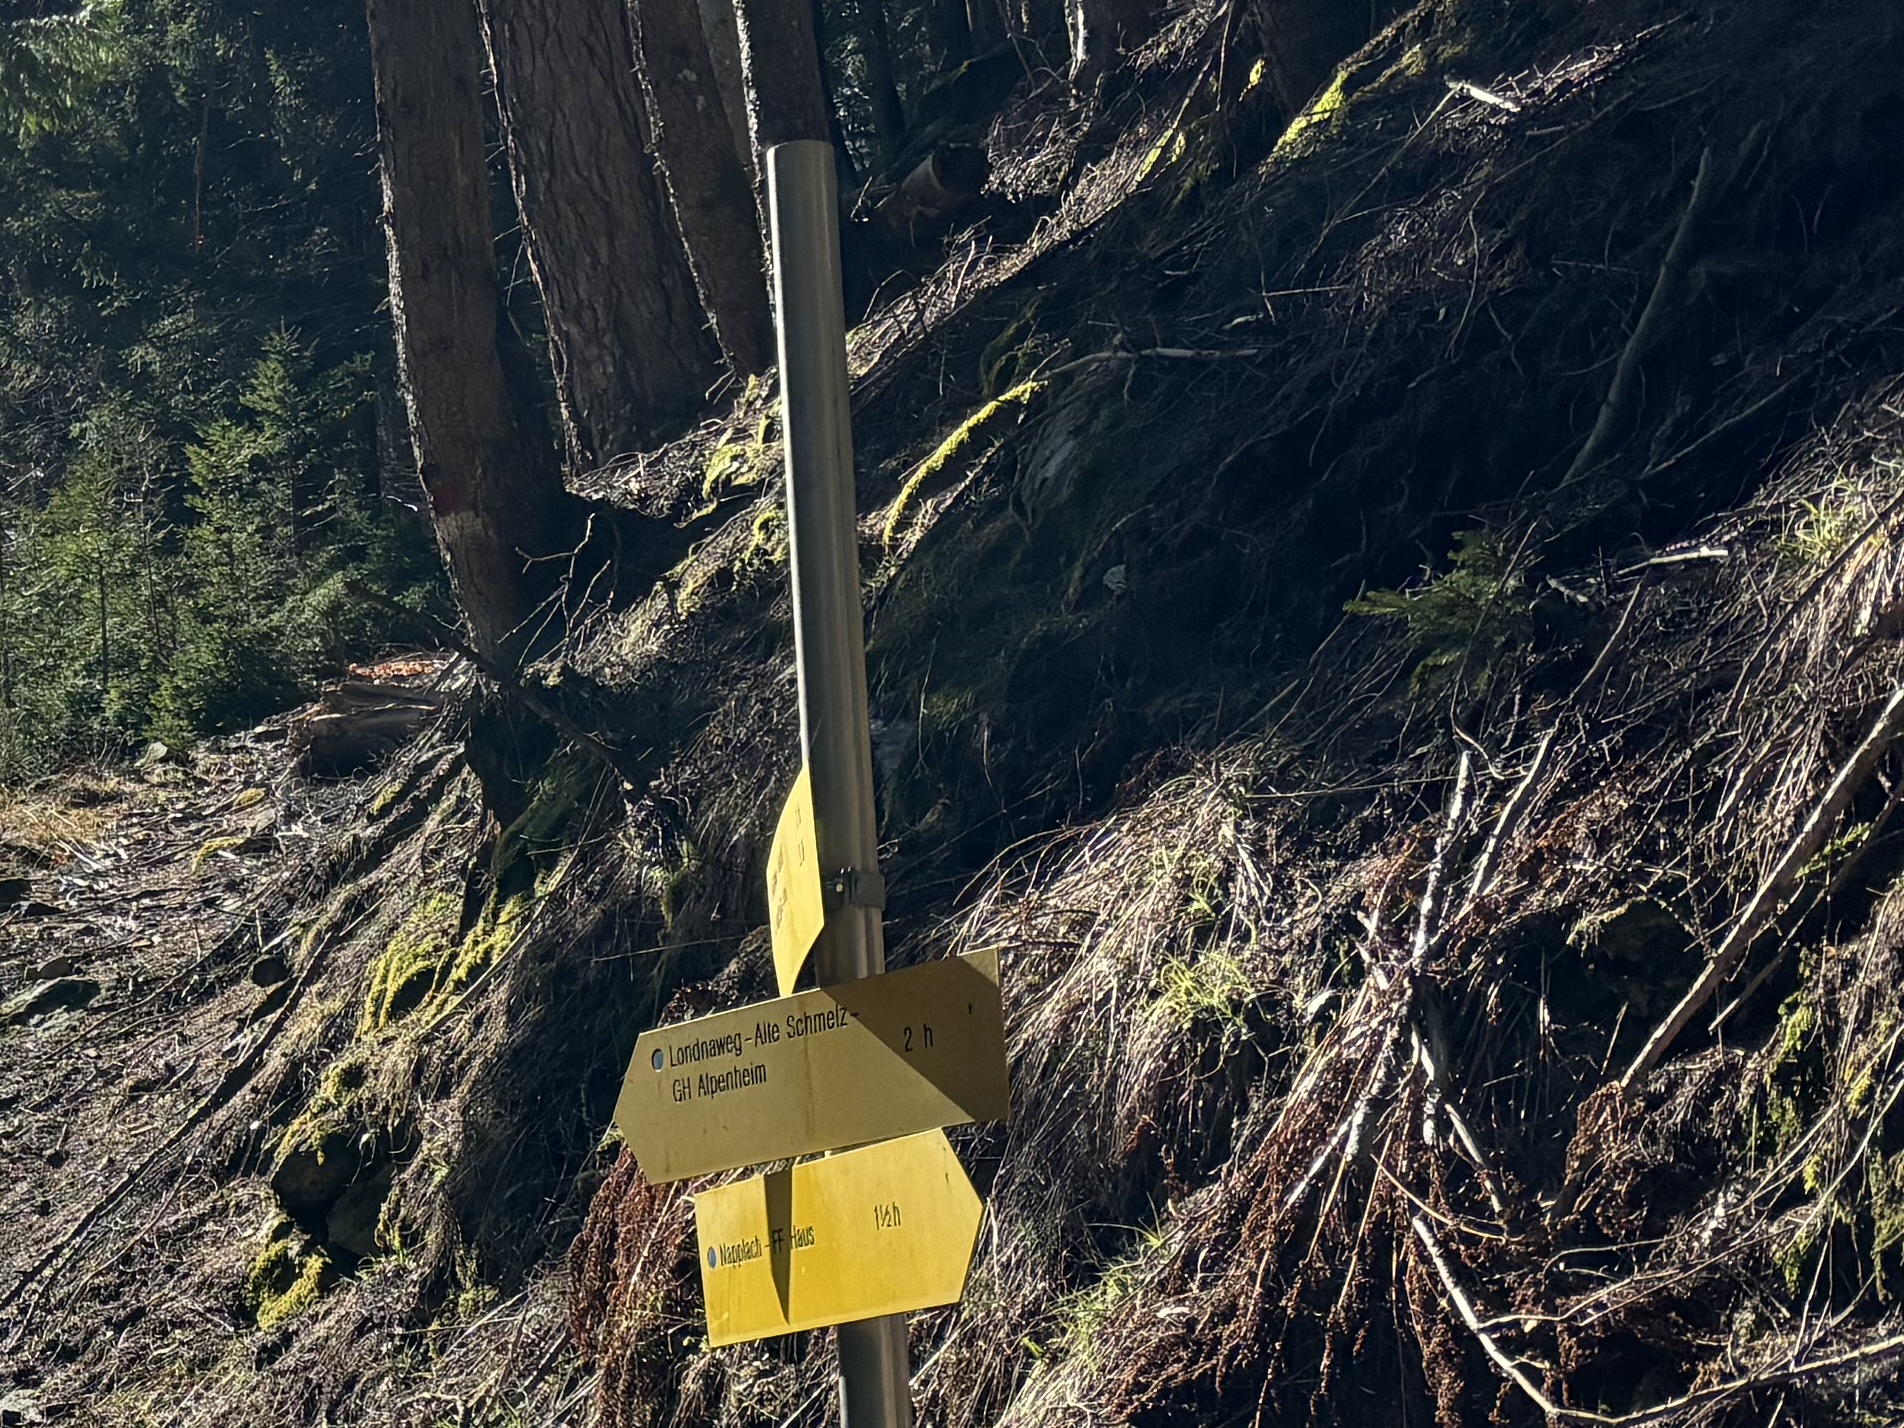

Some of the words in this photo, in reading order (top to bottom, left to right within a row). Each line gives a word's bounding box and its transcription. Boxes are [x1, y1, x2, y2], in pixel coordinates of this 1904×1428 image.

[903, 1026, 913, 1052] 2
[923, 1023, 934, 1049] h
[672, 1075, 691, 1102] GH
[697, 1062, 767, 1098] Alpenheim
[790, 1224, 815, 1251] Haus
